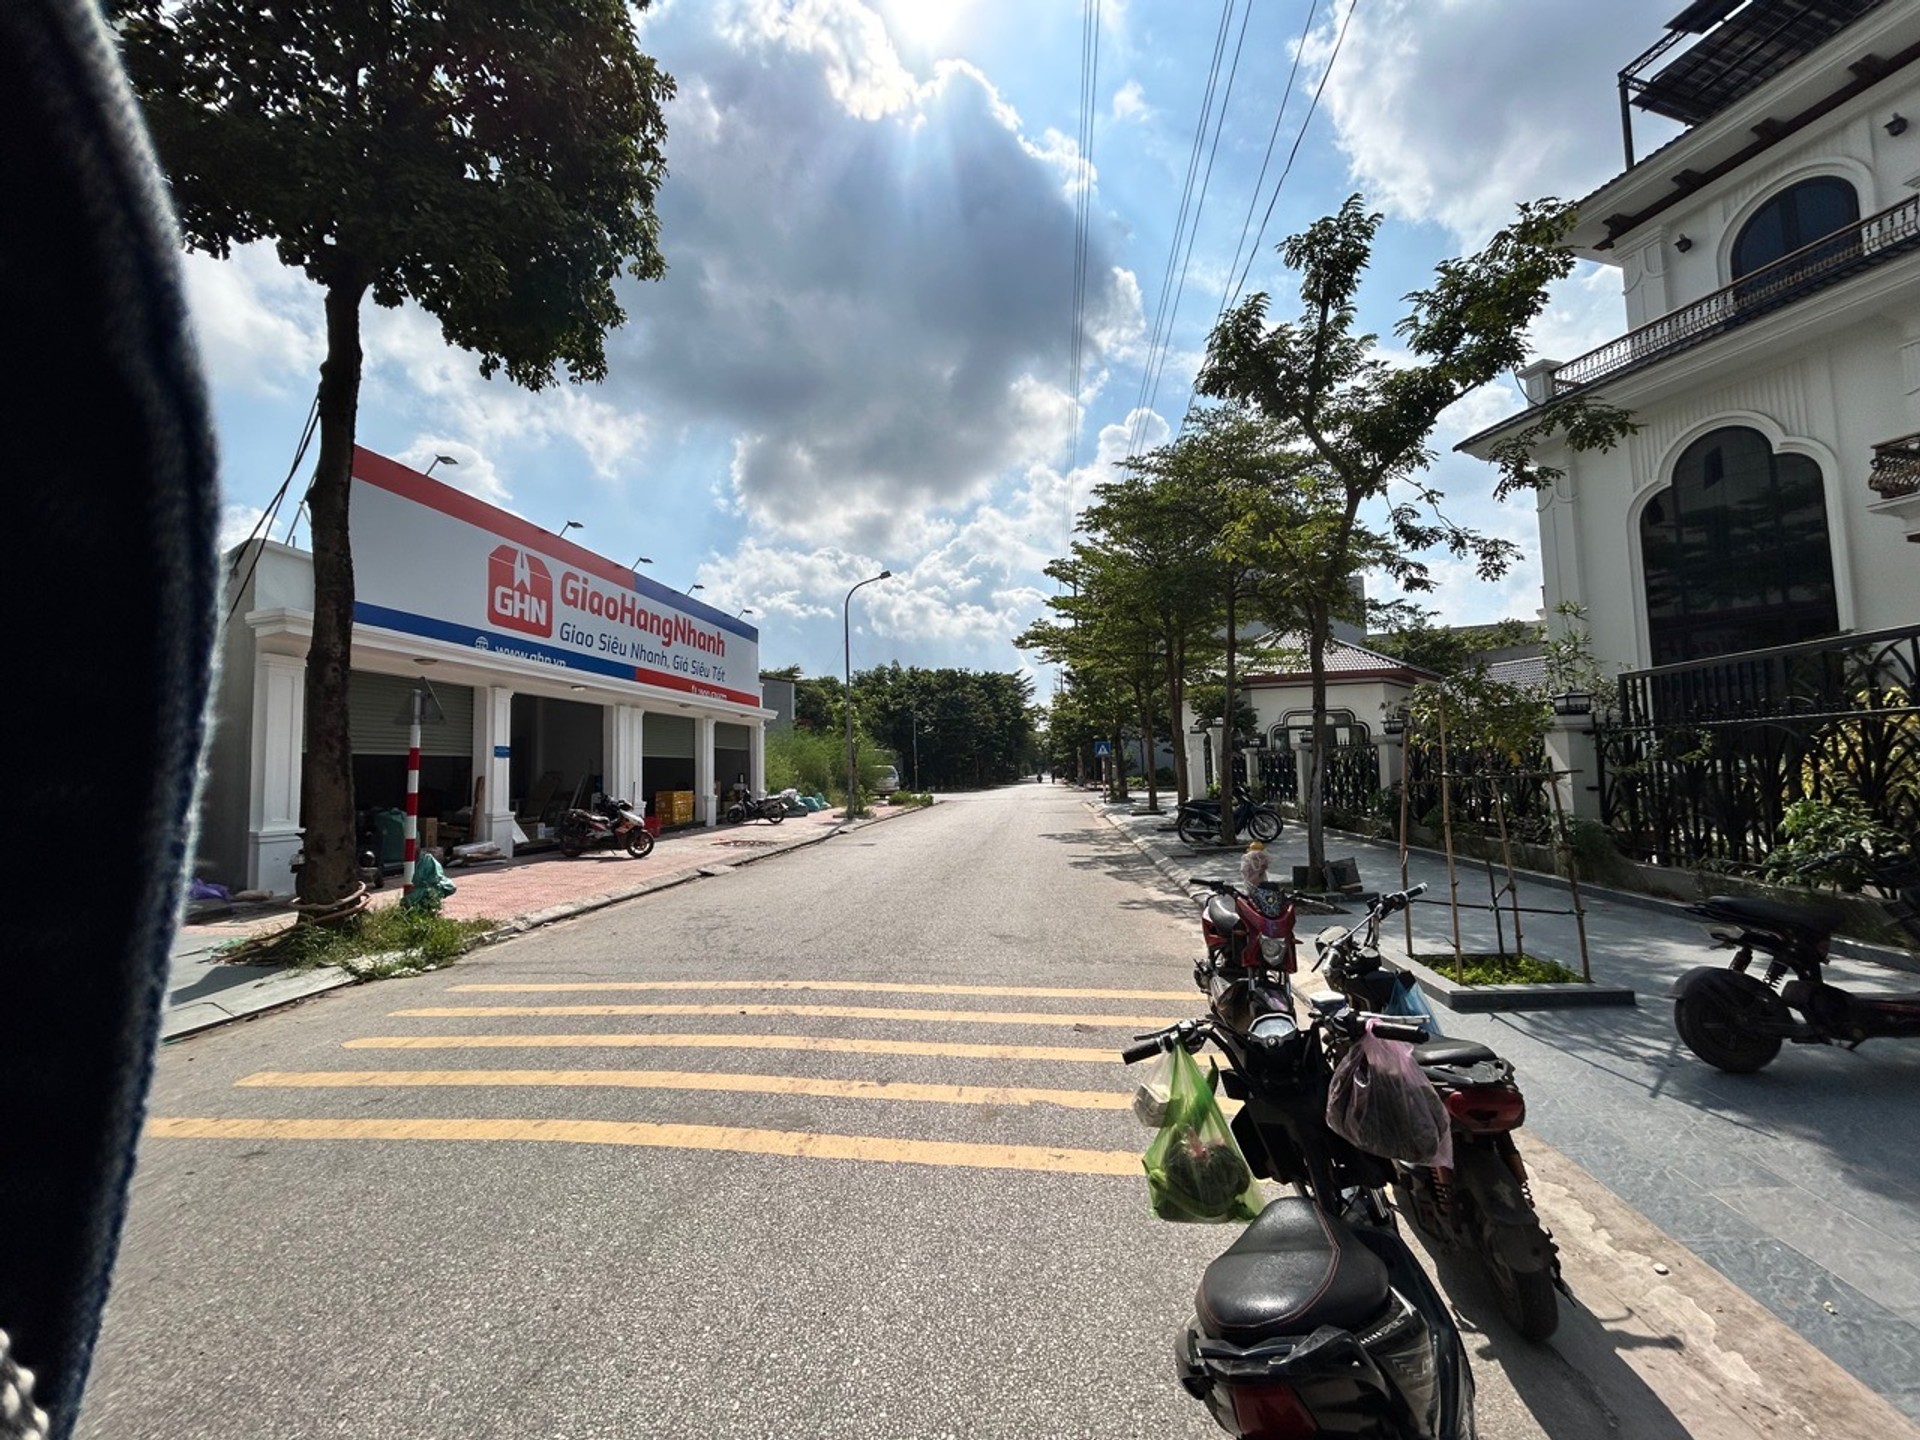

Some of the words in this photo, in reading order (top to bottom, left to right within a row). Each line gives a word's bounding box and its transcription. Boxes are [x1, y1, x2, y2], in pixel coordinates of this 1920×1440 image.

[494, 585, 547, 626] GHN
[561, 571, 725, 657] GiaoHangNhanh
[495, 646, 567, 667] wwwghnvn
[560, 622, 594, 648] Giao
[598, 633, 627, 656] Siêu
[630, 642, 670, 669] Nhanh,
[673, 654, 689, 672] Giá
[691, 660, 709, 678] Siêu
